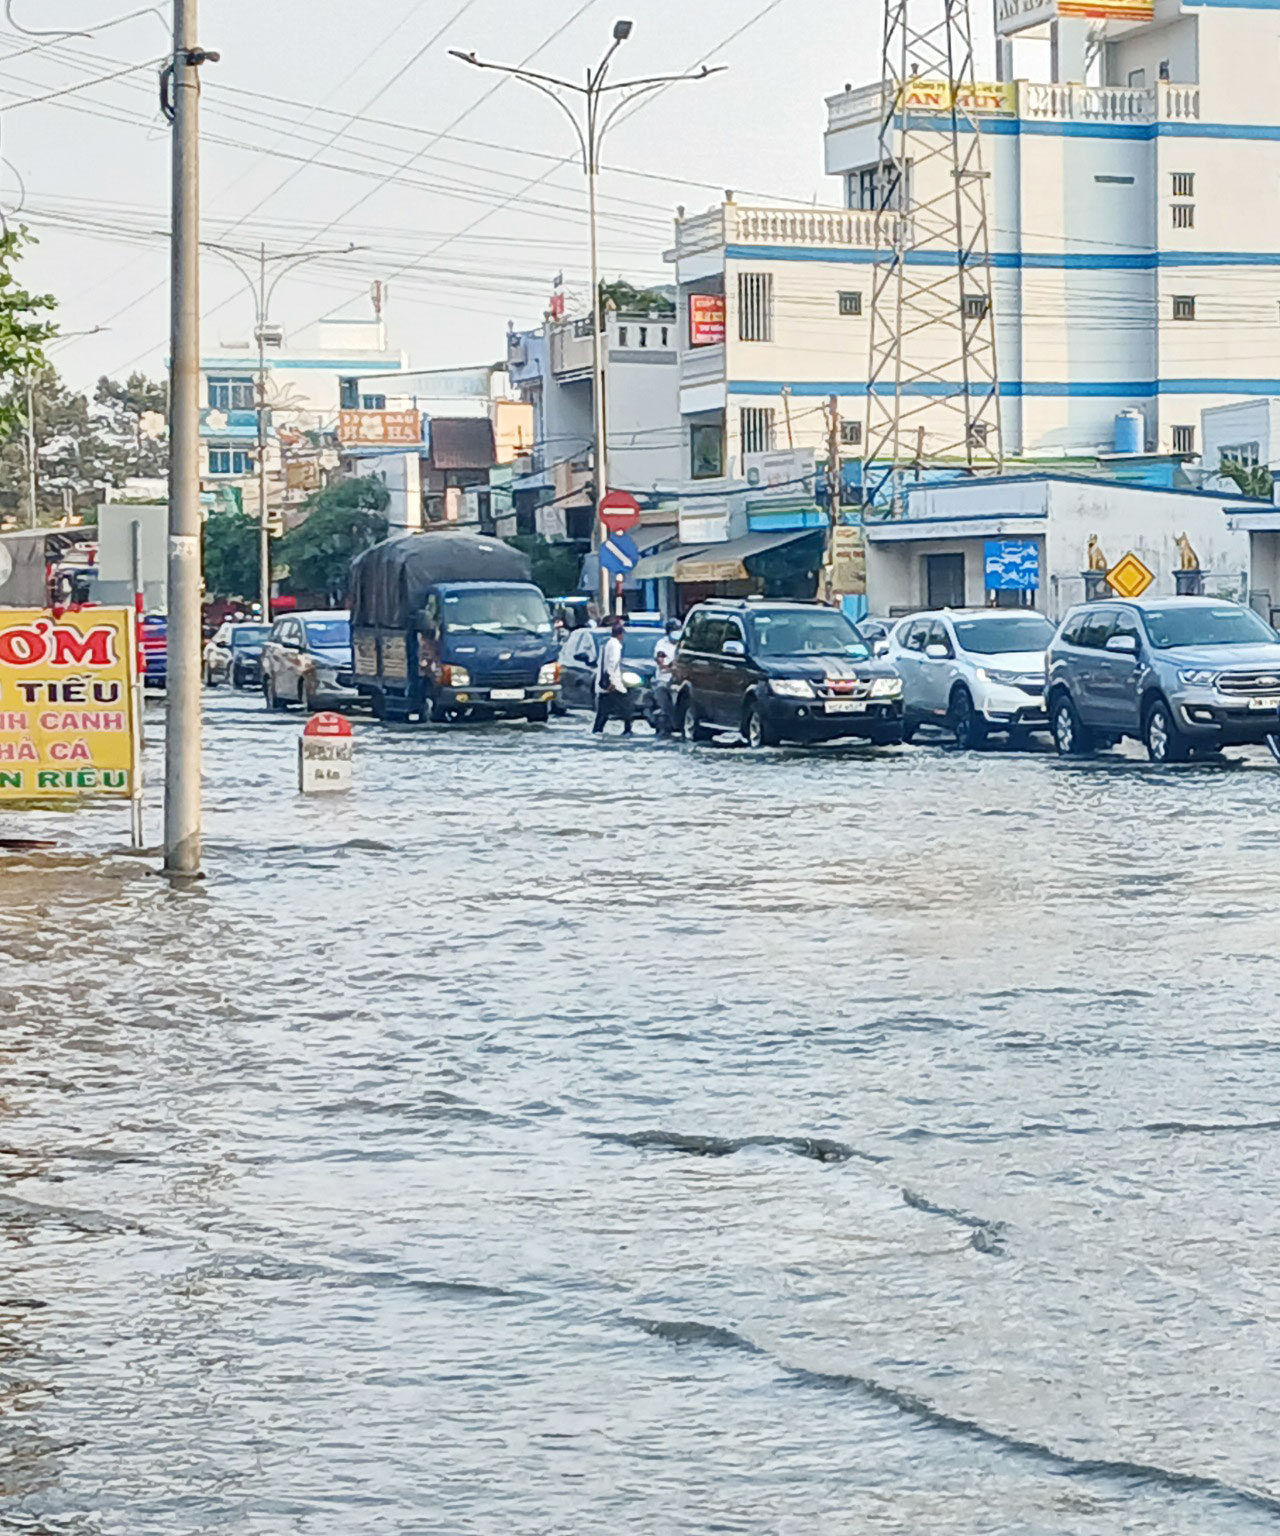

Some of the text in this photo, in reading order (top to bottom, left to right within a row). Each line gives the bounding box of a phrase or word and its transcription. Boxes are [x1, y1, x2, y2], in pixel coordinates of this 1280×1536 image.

[905, 93, 940, 105] AN
[0, 712, 123, 731] H CANH
[50, 738, 91, 761] CÁ
